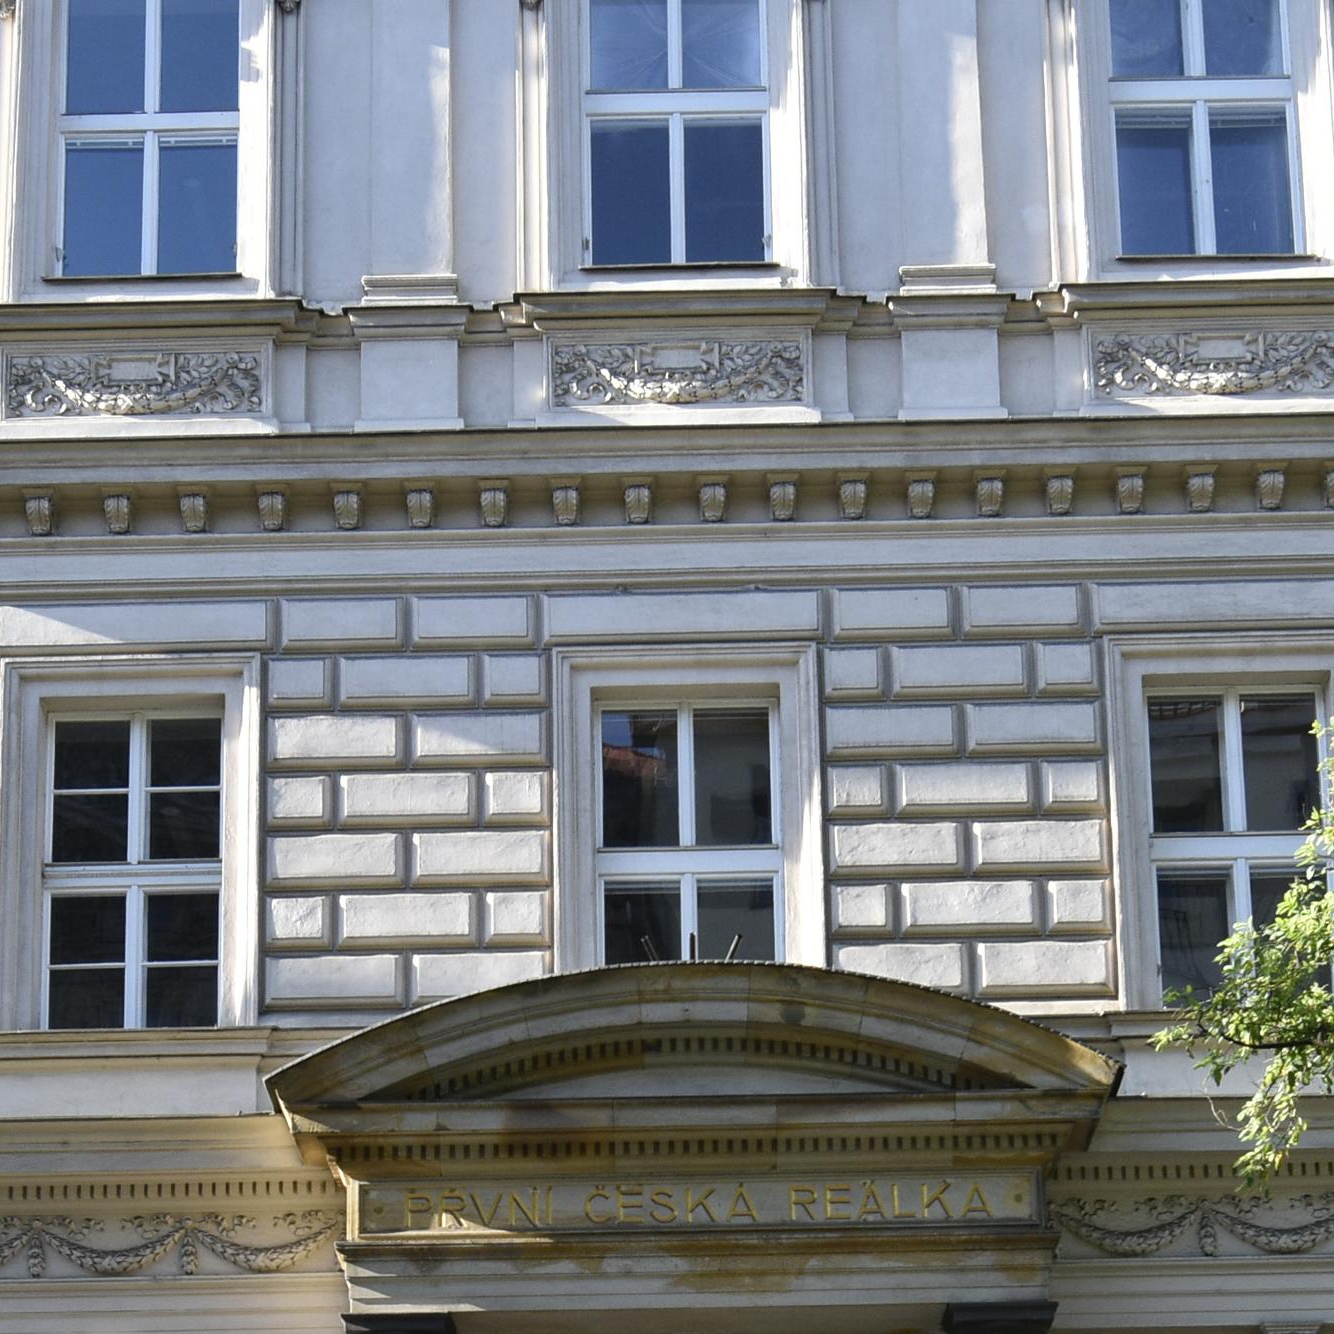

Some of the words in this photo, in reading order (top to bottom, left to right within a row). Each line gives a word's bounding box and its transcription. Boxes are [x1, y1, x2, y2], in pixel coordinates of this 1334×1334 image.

[405, 1185, 554, 1229] PRVNÍ
[583, 1181, 759, 1225] ČESKÁ
[788, 1179, 992, 1221] REÁLKA
